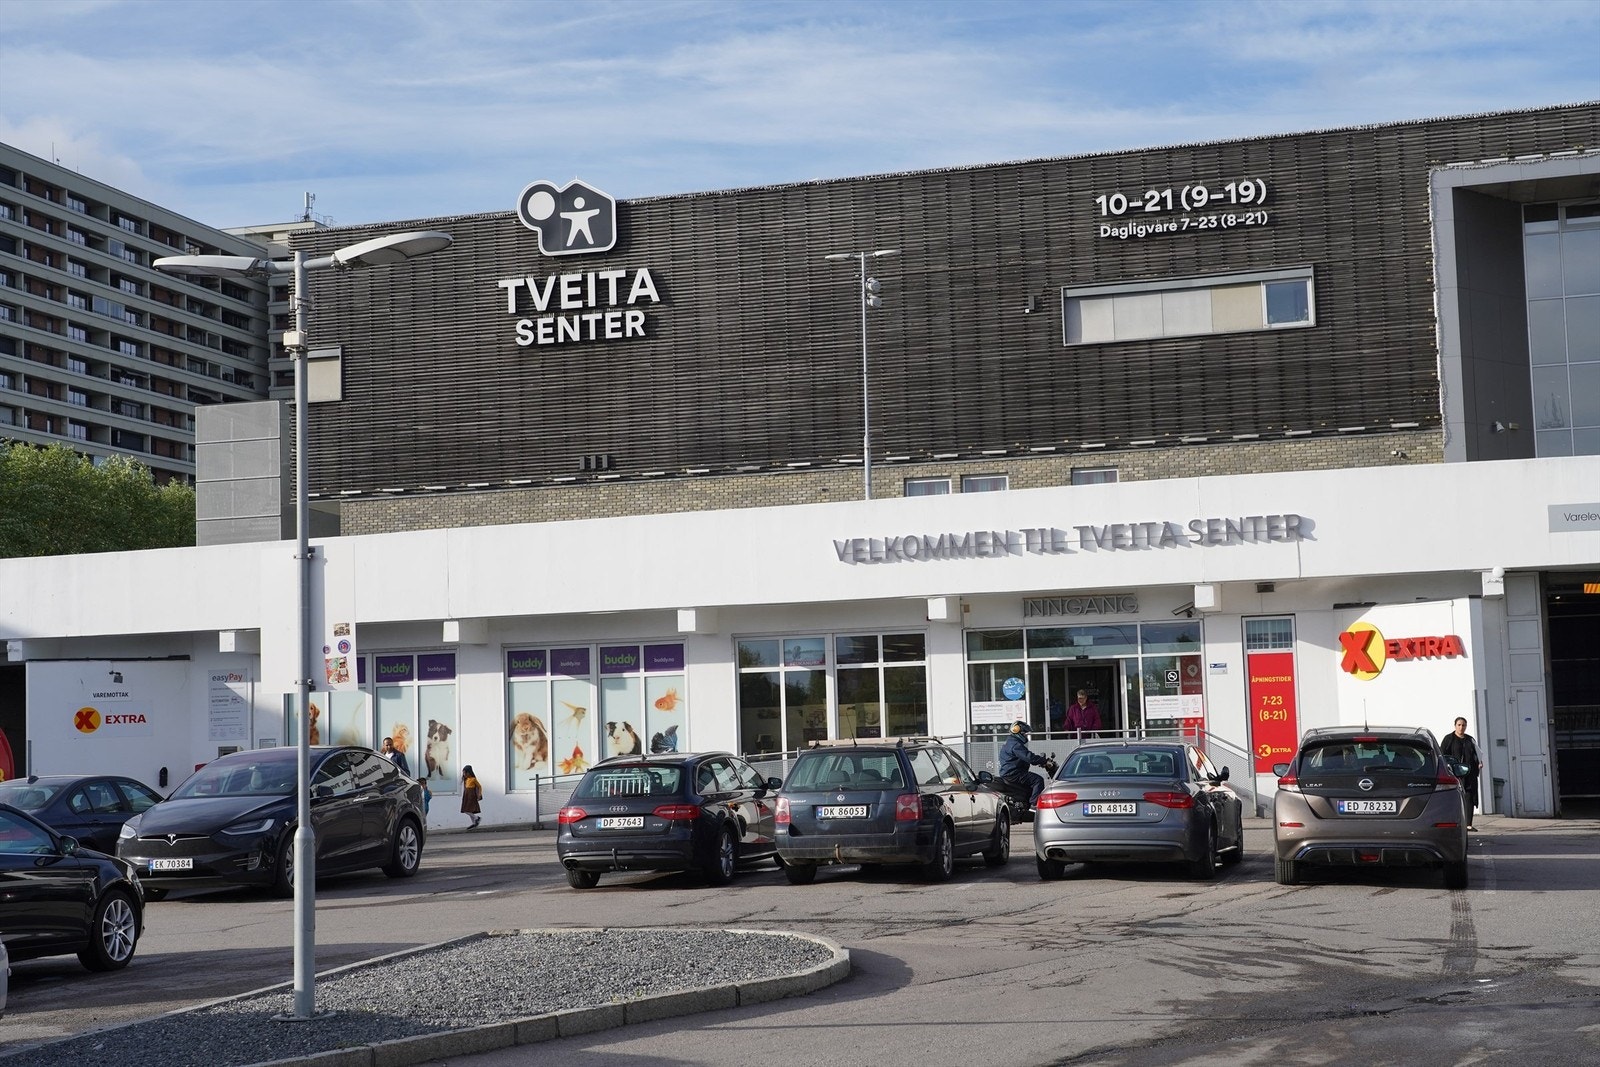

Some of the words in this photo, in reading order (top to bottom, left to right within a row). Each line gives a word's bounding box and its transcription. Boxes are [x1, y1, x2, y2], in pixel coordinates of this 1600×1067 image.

[1100, 222, 1178, 240] Dagligvare
[498, 267, 661, 315] TVEITA
[514, 310, 646, 346] SENTER
[832, 529, 1010, 562] VELKOMMEN
[1019, 527, 1065, 552] TIL
[1072, 521, 1178, 549] TVEITA
[1188, 513, 1305, 545] SENTER
[1384, 634, 1464, 660] EXTRA
[511, 658, 543, 669] buddy
[604, 653, 637, 666] buddy
[380, 663, 411, 675] buddy
[211, 673, 243, 683] easyPay
[1251, 675, 1292, 683] ÅPNINGSTIDER
[1262, 695, 1283, 706] 7-23
[105, 714, 147, 725] EXTRA
[1259, 708, 1288, 722] (8-21)
[823, 808, 835, 816] DK
[838, 807, 865, 816] 86053
[1090, 804, 1103, 813] DR
[1106, 804, 1134, 813] 48143
[1346, 801, 1360, 811] ED
[1363, 801, 1394, 811] 78232
[603, 818, 614, 827] DP
[617, 817, 642, 827] 57643
[155, 860, 164, 869] EK
[167, 859, 191, 868] 70384
